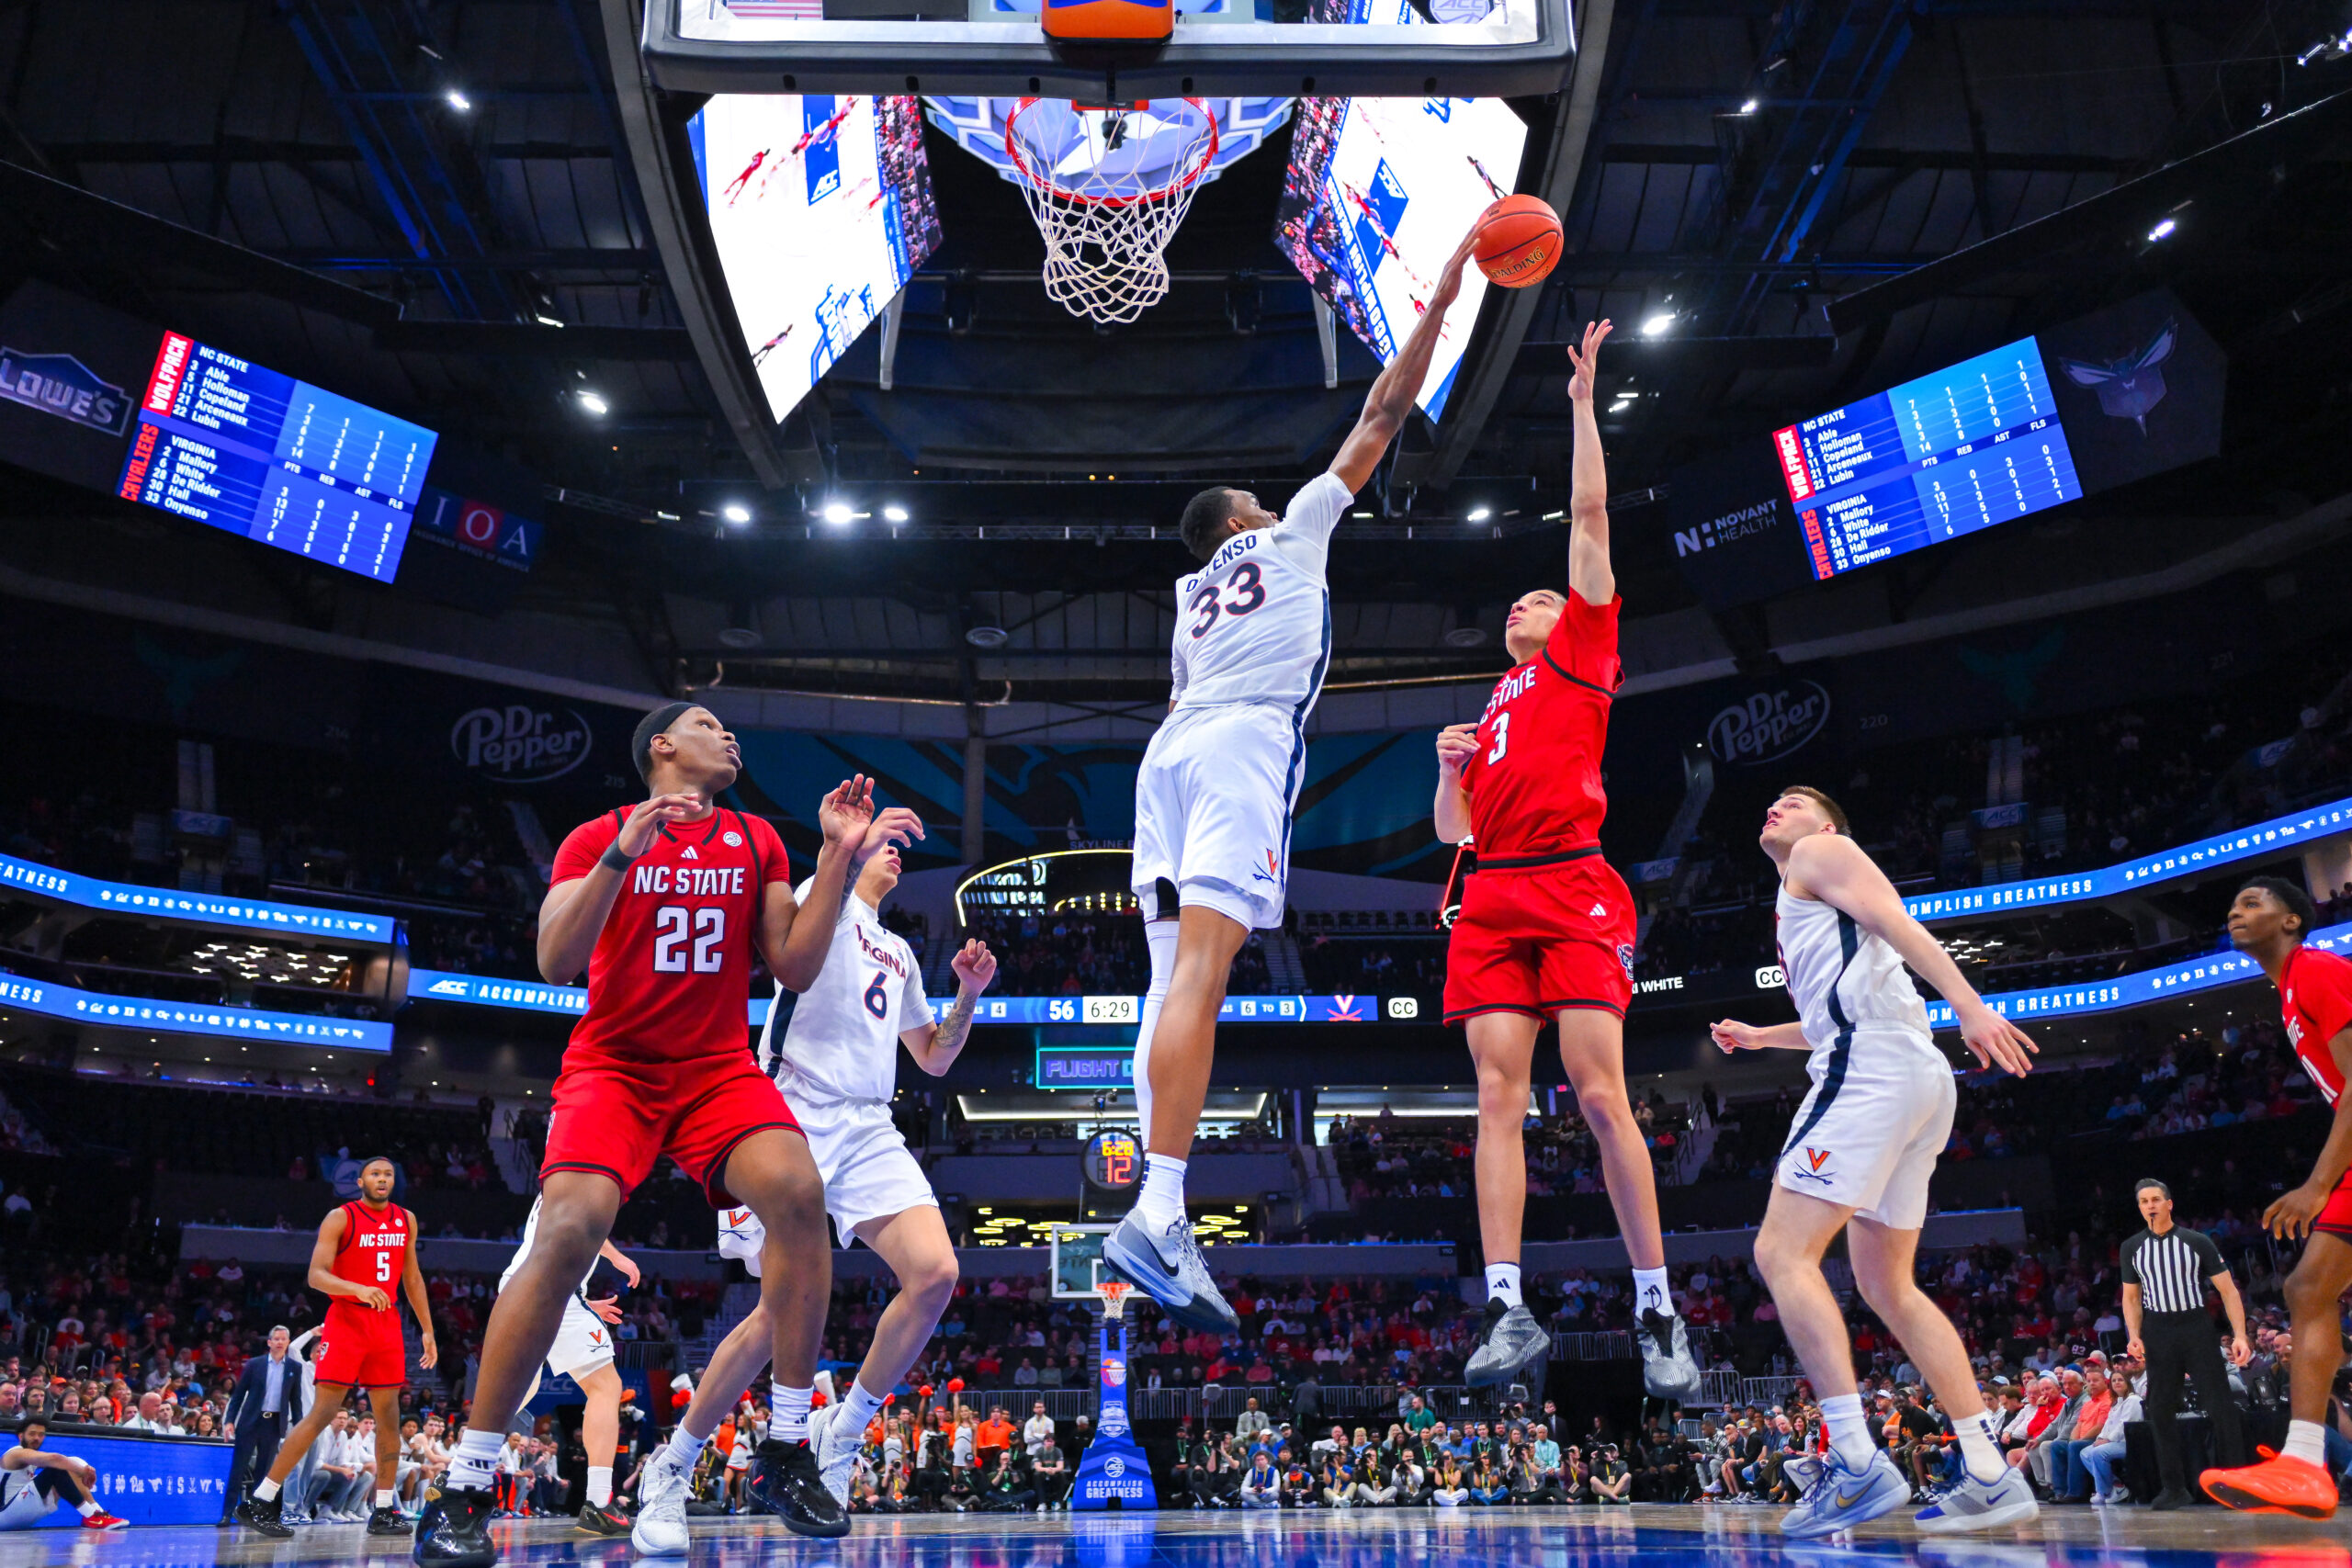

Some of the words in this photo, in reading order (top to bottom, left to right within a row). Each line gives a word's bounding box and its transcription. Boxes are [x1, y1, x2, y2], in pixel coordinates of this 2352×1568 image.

[148, 336, 187, 411] WOLFPACK
[189, 359, 198, 371] 3
[205, 366, 230, 383] Able
[198, 345, 215, 360] NC
[216, 353, 248, 373] STATE
[0, 358, 113, 423] LOWE'S
[182, 381, 194, 394] 11
[198, 388, 246, 413] Copeland
[187, 371, 195, 382] 5
[202, 377, 250, 403] Holloman
[1803, 437, 1811, 447] 3
[1817, 428, 1838, 443] Able
[1908, 399, 1915, 410] 7
[1945, 386, 1951, 396] 1
[1981, 373, 1987, 383] 1
[2017, 359, 2023, 369] 1
[172, 403, 187, 417] 22
[191, 410, 220, 429] Lubin
[176, 391, 190, 405] 21
[195, 399, 248, 426] Arceneaux
[1803, 419, 1816, 432] NC
[1816, 409, 1845, 426] STATE
[1806, 447, 1814, 458] 5
[1819, 432, 1862, 454] Holloman
[1911, 410, 1919, 420] 3
[1948, 397, 1954, 407] 1
[1984, 384, 1991, 394] 1
[2019, 371, 2027, 381] 0
[1807, 457, 1819, 468] 11
[1823, 440, 1864, 463] Copeland
[1915, 421, 1922, 431] 6
[1951, 407, 1958, 418] 3
[1987, 394, 1994, 404] 4
[2023, 381, 2030, 391] 1
[171, 434, 215, 459] VIRGINIA
[1810, 467, 1822, 479] 21
[1826, 450, 1872, 474] Arceneaux
[1917, 431, 1926, 441] 3
[1953, 418, 1962, 429] 2
[1990, 405, 1997, 416] 0
[2027, 392, 2033, 402] 1
[1813, 478, 1826, 491] 22
[1828, 469, 1854, 485] Lubin
[1918, 441, 1931, 453] 14
[1957, 429, 1964, 440] 8
[1993, 417, 2001, 427] 0
[2030, 404, 2037, 414] 1
[1921, 456, 1938, 468] PTS
[1956, 444, 1973, 456] REB
[1995, 430, 2009, 443] AST
[2030, 419, 2046, 431] FLS
[119, 423, 161, 502] CAVALIERS
[159, 457, 166, 468] 6
[175, 462, 205, 481] White
[162, 446, 171, 457] 2
[178, 450, 217, 473] Mallory
[1778, 429, 1809, 499] WOLFPACK
[149, 478, 164, 491] 30
[167, 484, 190, 501] Hall
[152, 467, 167, 479] 28
[171, 472, 187, 487] De
[187, 478, 220, 498] Ridder
[1826, 516, 1834, 527] 2
[1839, 504, 1873, 523] Mallory
[1932, 480, 1940, 491] 3
[1969, 468, 1976, 479] 0
[2005, 457, 2013, 467] 3
[2041, 444, 2050, 455] 0
[1829, 526, 1837, 537] 6
[1842, 518, 1869, 533] White
[1933, 491, 1947, 503] 13
[1973, 479, 1980, 490] 1
[2008, 468, 2016, 479] 0
[2045, 456, 2052, 466] 3
[144, 490, 160, 503] 33
[164, 497, 208, 519] Onyenso
[1714, 499, 1778, 530] NOVANT
[1826, 493, 1867, 514] VIRGINIA
[1829, 536, 1842, 548] 28
[1846, 532, 1859, 543] De
[1859, 522, 1888, 539] Ridder
[1937, 502, 1950, 513] 11
[1975, 491, 1983, 501] 3
[2012, 478, 2018, 488] 1
[2049, 467, 2056, 476] 1
[1832, 547, 1845, 558] 30
[1849, 539, 1868, 554] Hall
[1942, 513, 1949, 524] 7
[1979, 501, 1986, 512] 5
[2015, 489, 2023, 500] 5
[2052, 478, 2060, 489] 2
[1718, 514, 1778, 544] HEALTH
[1802, 509, 1834, 580] CAVALIERS
[1836, 558, 1849, 570] 33
[1852, 546, 1891, 564] Onyenso
[1946, 525, 1953, 535] 6
[1982, 513, 1990, 524] 5
[2018, 502, 2026, 512] 0
[2056, 490, 2063, 499] 1
[1189, 561, 1266, 639] 33
[1489, 665, 1539, 716] STATE
[504, 705, 553, 739] Dr
[1747, 690, 1789, 728] Dr
[1860, 714, 1888, 730] 220
[451, 706, 582, 773] Pepper
[1487, 711, 1511, 768] 3
[1708, 694, 1818, 762] Pepper
[1069, 840, 1125, 850] SKYLINE
[633, 865, 671, 895] NC
[674, 867, 746, 897] STATE
[1993, 879, 2092, 906] GREATNESS
[652, 905, 726, 973] 22
[428, 979, 469, 996] ACC
[1641, 976, 1683, 993] WHITE
[1759, 970, 1782, 985] CC
[479, 985, 586, 1009] ACCOMPLISH
[864, 970, 888, 1021] 6
[1049, 1000, 1075, 1021] 56
[1091, 1001, 1130, 1018] 6:29
[1261, 1003, 1274, 1013] TO
[1392, 1001, 1414, 1015] CC
[2017, 987, 2120, 1012] GREATNESS
[1046, 1059, 1119, 1077] FLIGHT
[1102, 1140, 1134, 1156] 6:28
[1107, 1156, 1132, 1184] 12
[359, 1234, 376, 1247] NC
[377, 1233, 406, 1247] STATE
[376, 1250, 390, 1282] 5
[1086, 1480, 1143, 1488] ACCOMPLISH
[1086, 1487, 1143, 1499] GREATNESS
